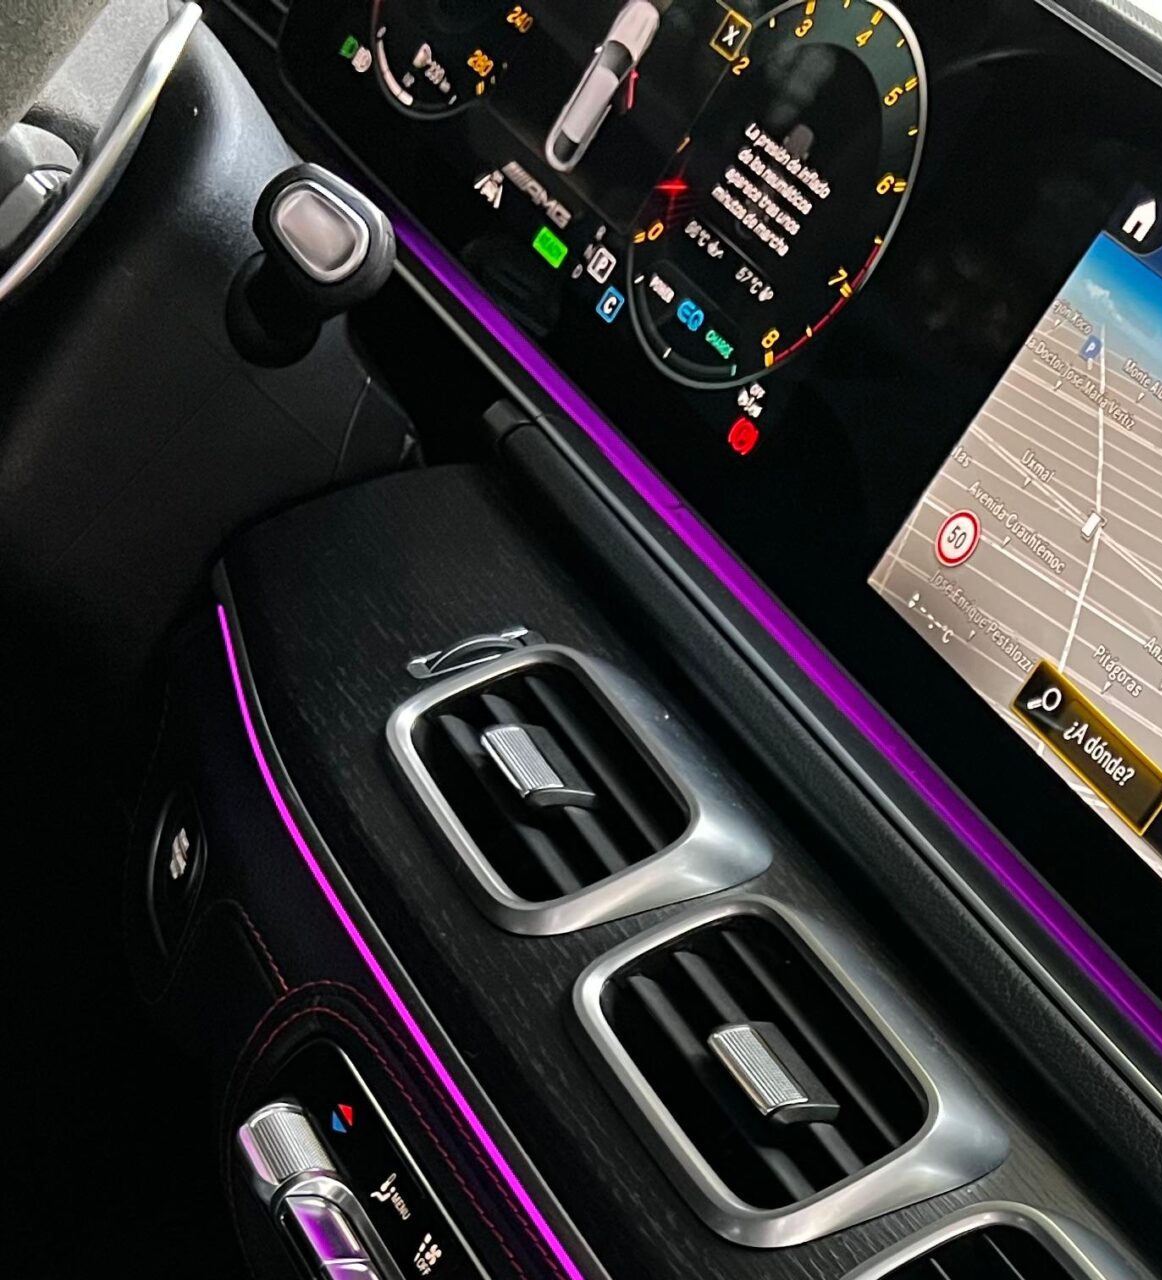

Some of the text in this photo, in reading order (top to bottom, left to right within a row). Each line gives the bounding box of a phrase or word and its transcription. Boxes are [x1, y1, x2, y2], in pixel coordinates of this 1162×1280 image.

[795, 19, 813, 37] 3
[855, 30, 873, 48] 4
[732, 56, 750, 75] 2
[884, 87, 902, 106] 5
[785, 154, 802, 176] de
[876, 173, 894, 194] 6
[741, 209, 758, 231] de
[648, 222, 665, 241] 0
[828, 268, 847, 287] 7
[761, 329, 780, 349] 8
[1034, 341, 1065, 373] Doctor
[1122, 358, 1151, 389] Monte
[1020, 448, 1055, 485] Uxmal
[945, 523, 969, 551] 50
[967, 478, 1066, 575] Avenida Cuauhtémoc
[1092, 643, 1143, 697] Pitágoras
[1061, 715, 1135, 789] ¿A dónde?
[416, 1257, 433, 1277] OFF
